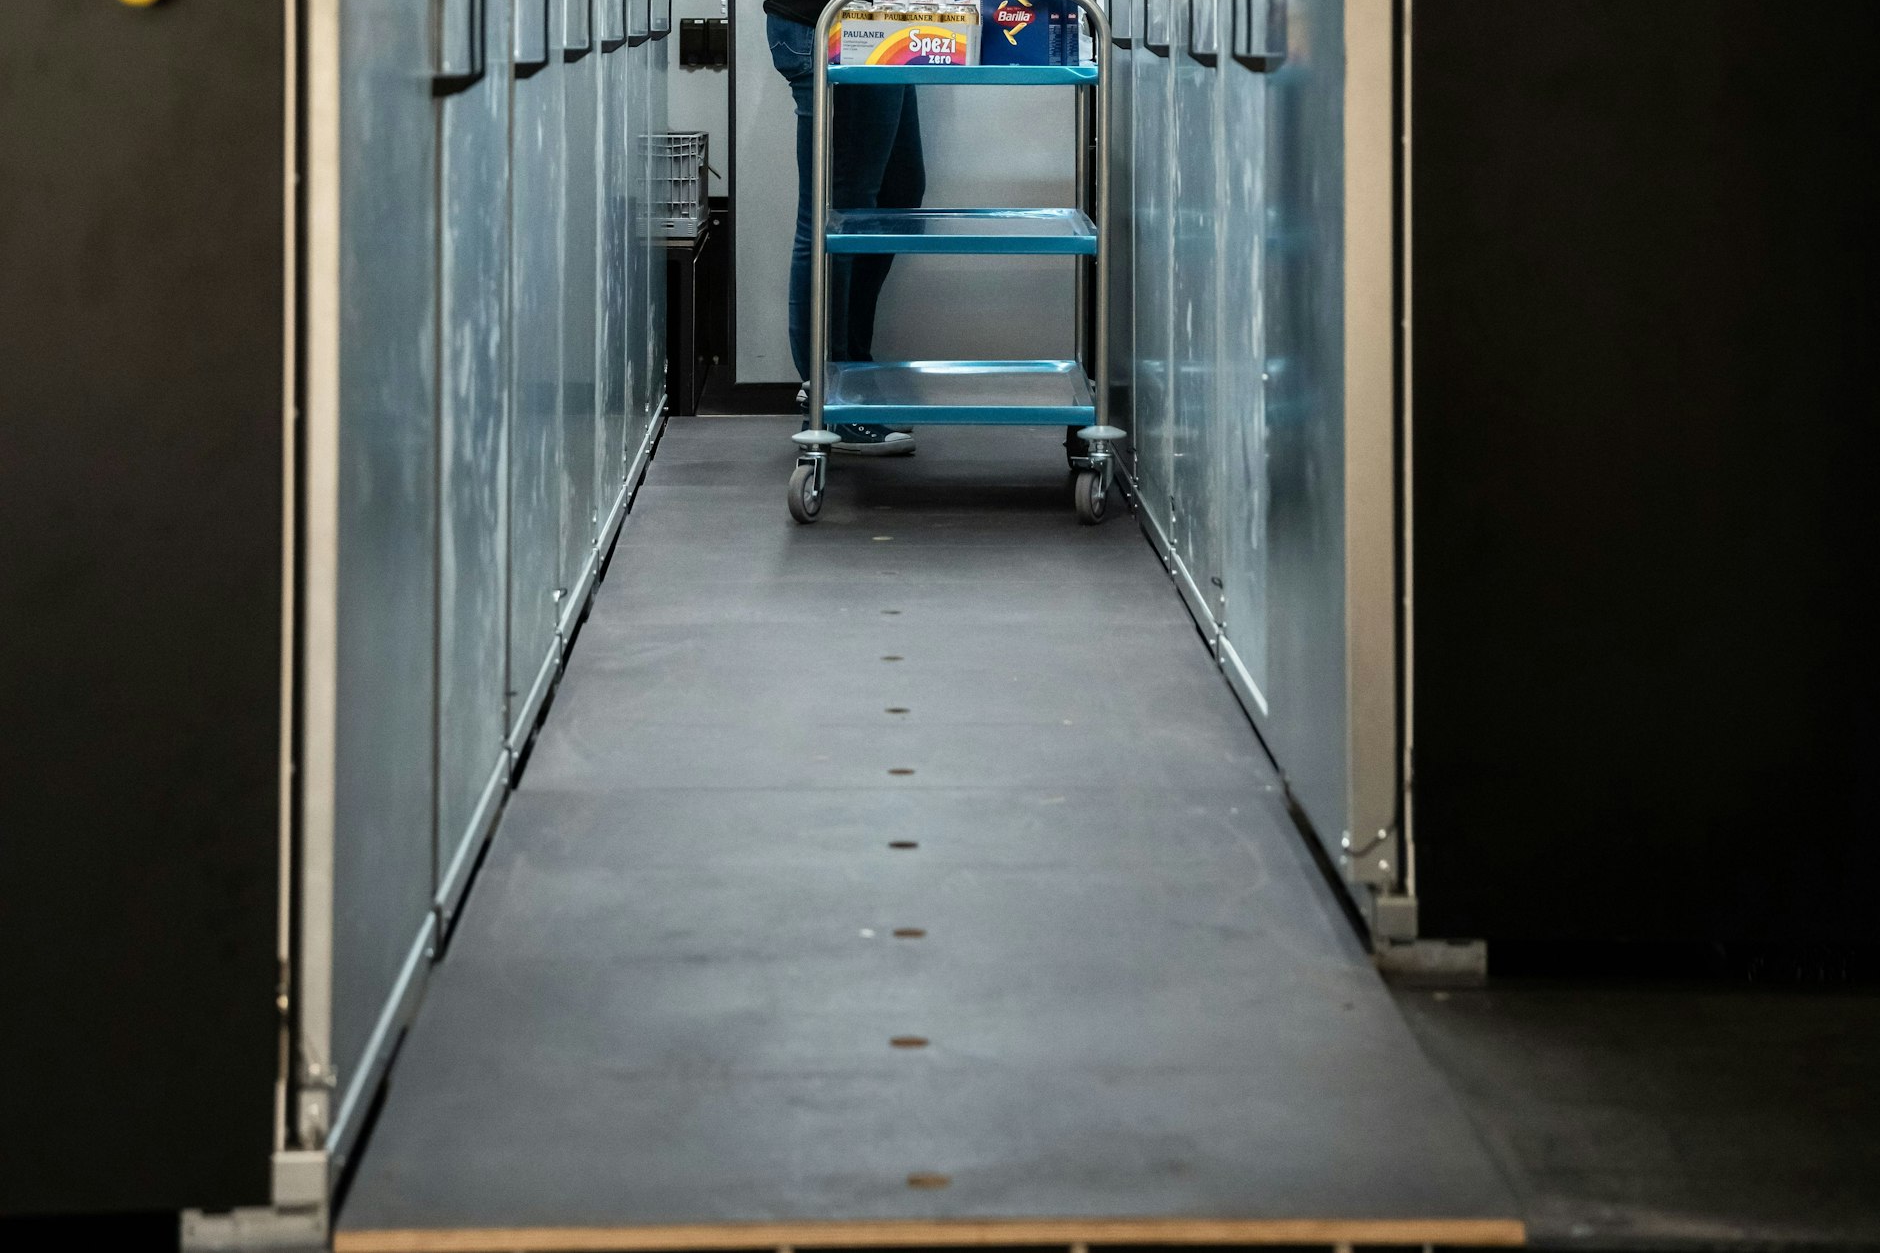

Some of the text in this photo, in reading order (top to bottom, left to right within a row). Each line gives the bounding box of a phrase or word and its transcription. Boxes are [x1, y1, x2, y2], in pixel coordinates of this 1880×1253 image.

[997, 10, 1031, 22] Barilla
[843, 30, 885, 39] PAULANER
[908, 29, 957, 56] Spezi
[928, 55, 952, 65] zero
